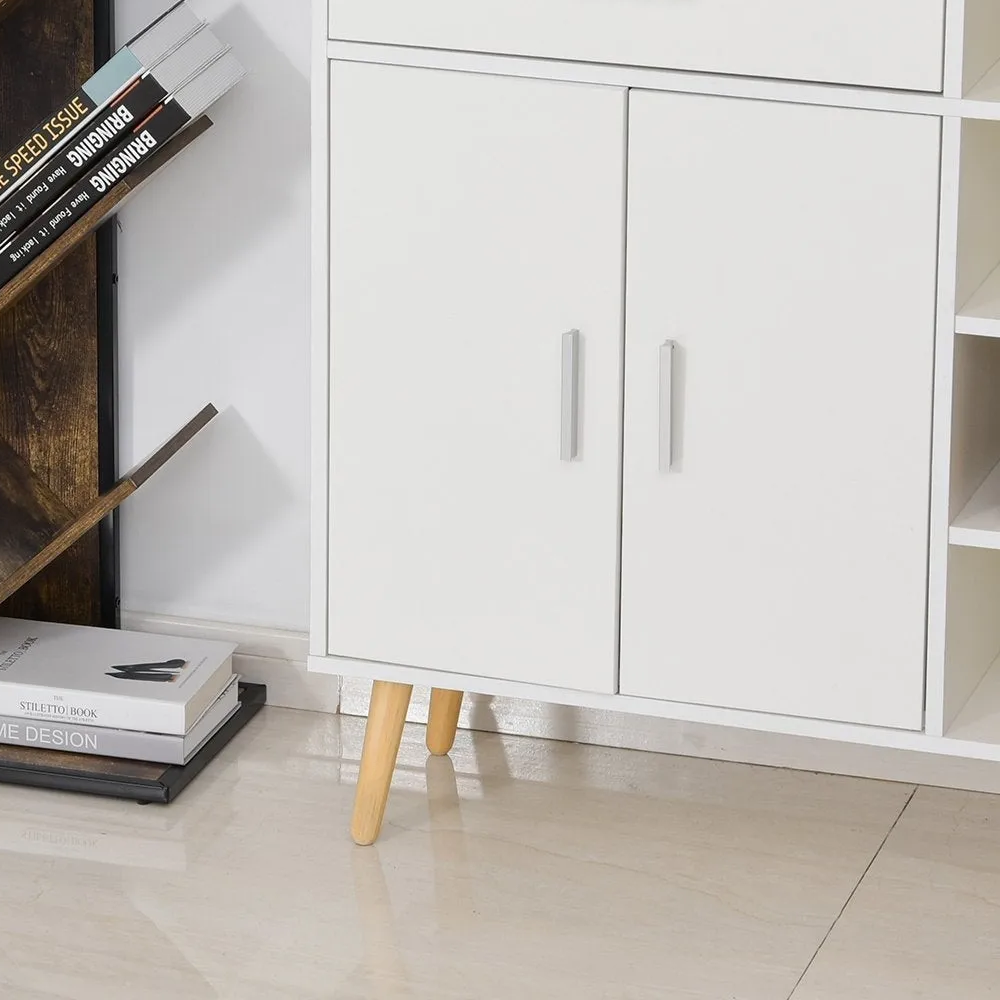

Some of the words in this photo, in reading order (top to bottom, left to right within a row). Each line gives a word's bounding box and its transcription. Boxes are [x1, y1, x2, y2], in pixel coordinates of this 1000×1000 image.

[4, 133, 48, 177] SPEED
[42, 96, 88, 139] ISSUE
[66, 105, 135, 168] BRINGING
[89, 129, 158, 193] BRINGING
[47, 166, 67, 183] Have
[26, 181, 49, 202] Found
[70, 191, 90, 208] Have
[16, 199, 27, 212] it
[49, 207, 72, 229] Found
[38, 225, 50, 238] it
[10, 238, 40, 263] lacking
[20, 701, 65, 714] STILETTO
[71, 707, 98, 718] BOOK
